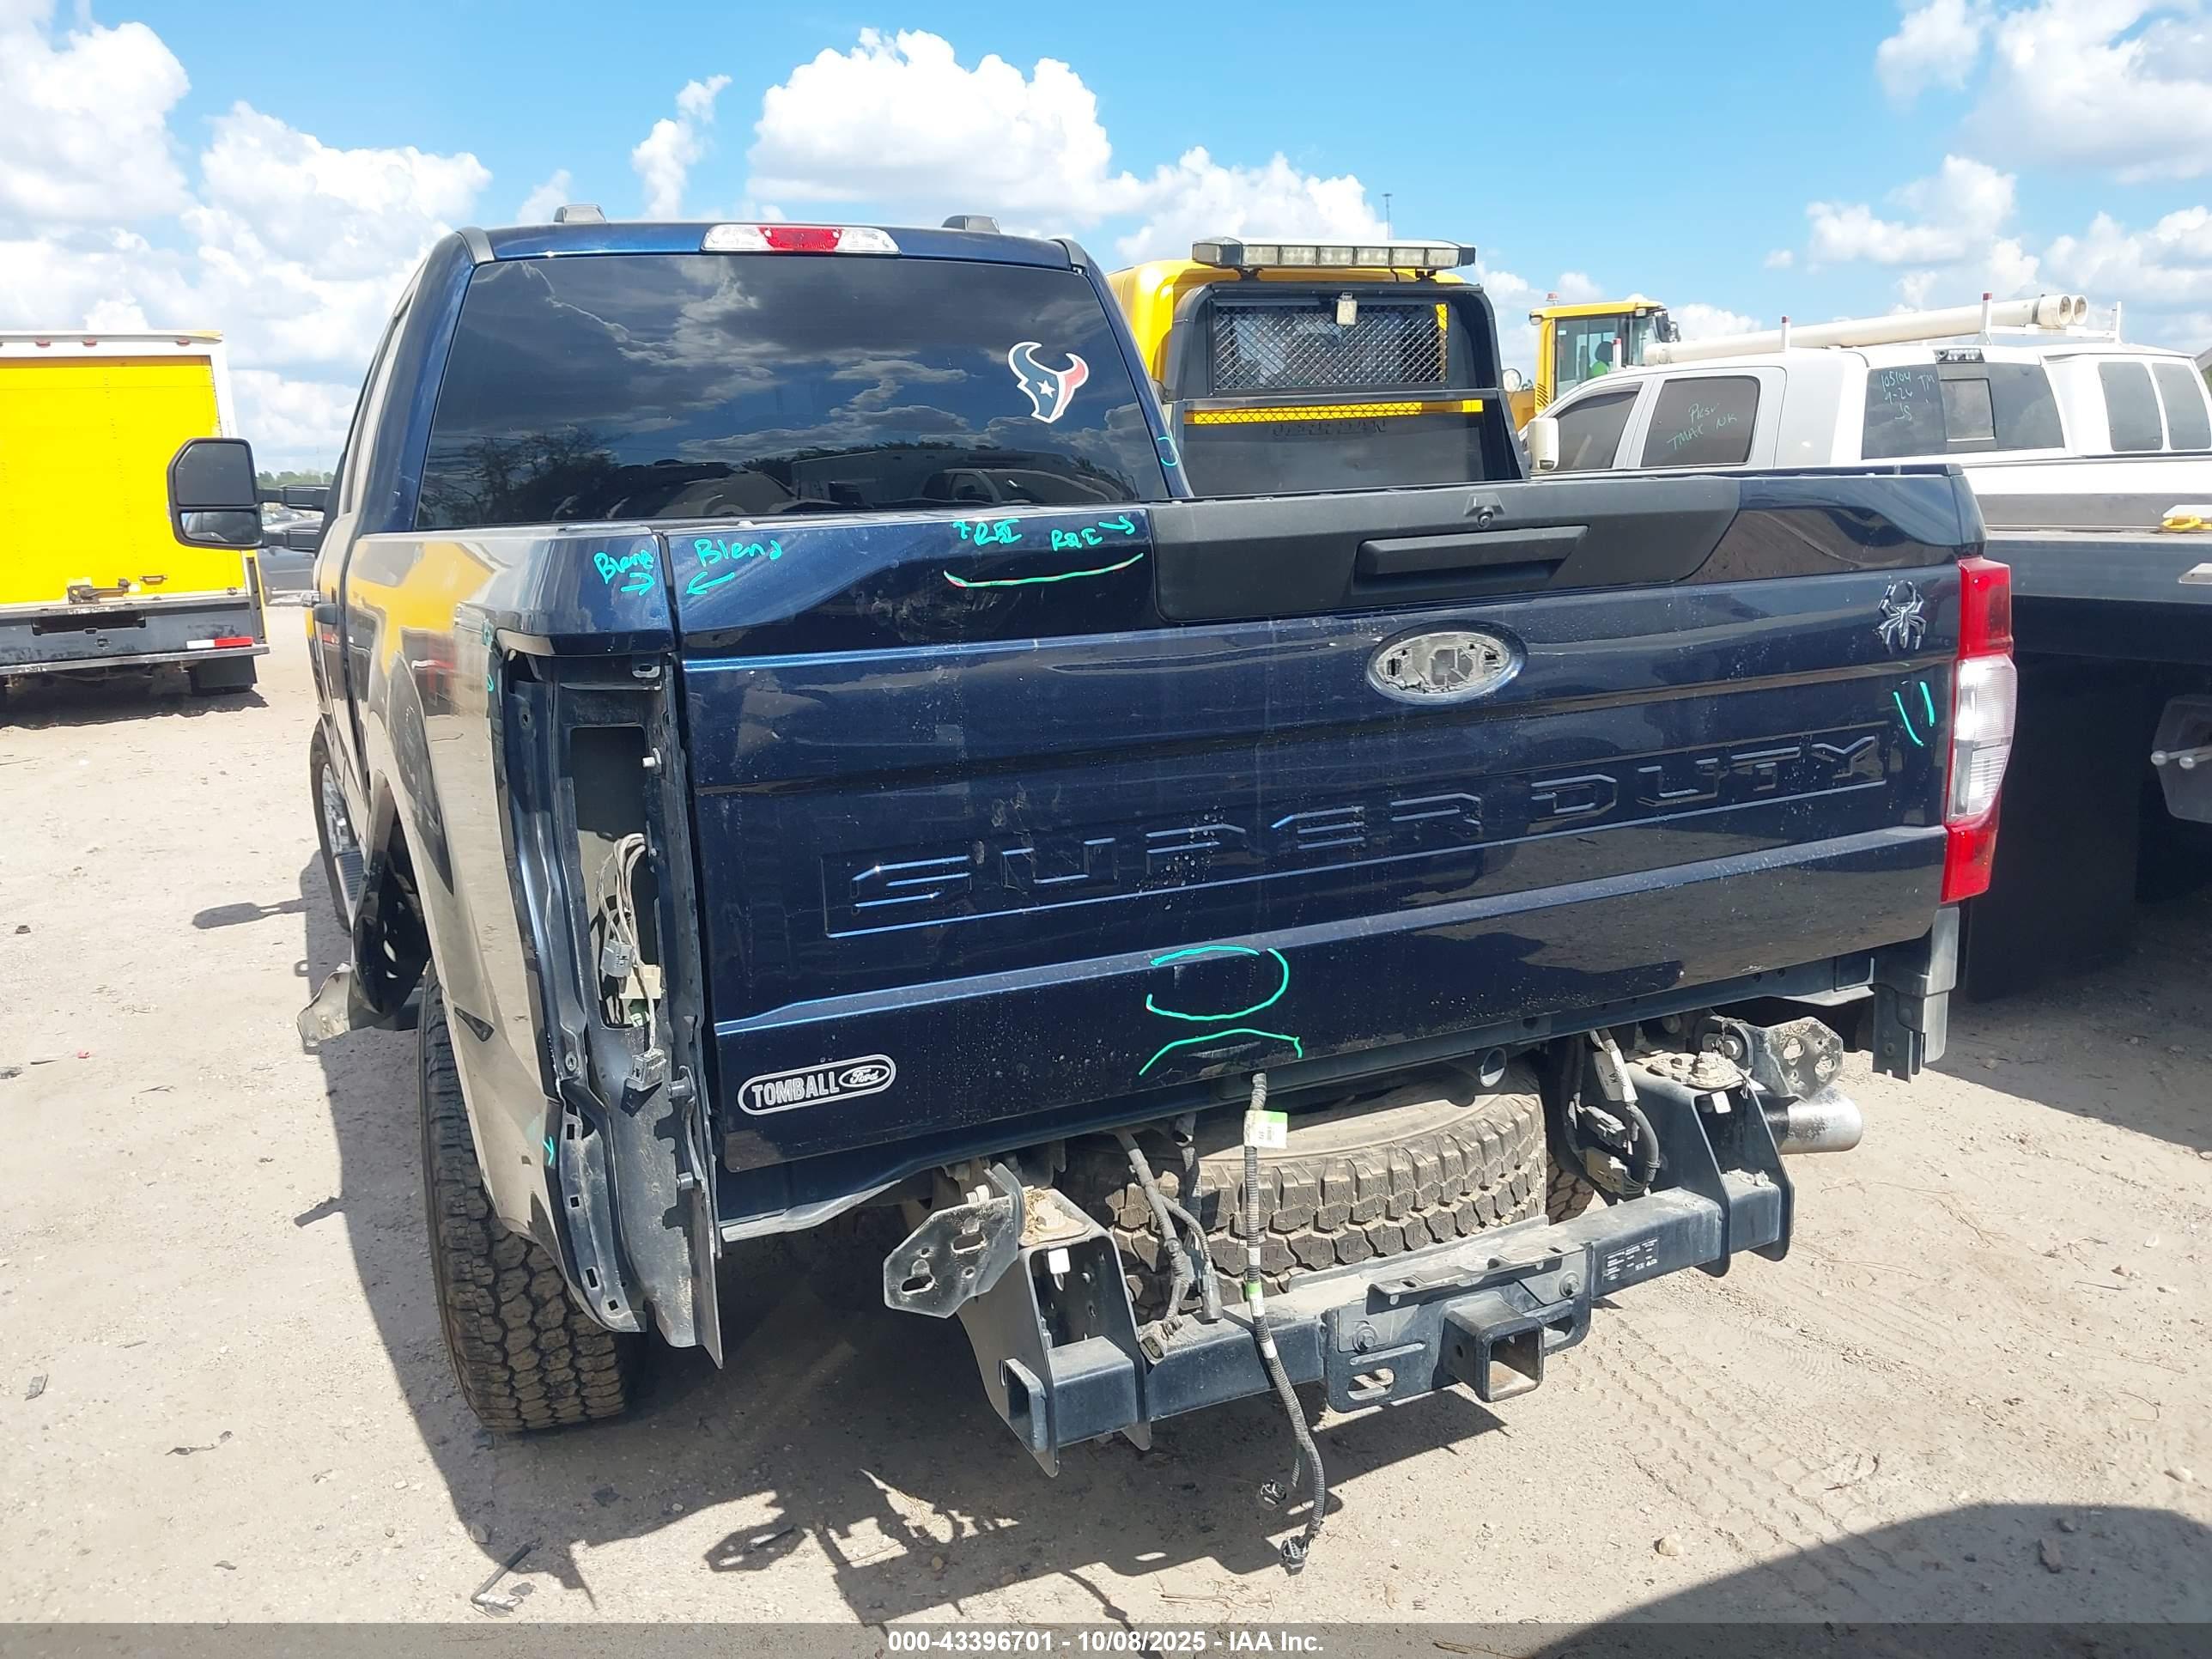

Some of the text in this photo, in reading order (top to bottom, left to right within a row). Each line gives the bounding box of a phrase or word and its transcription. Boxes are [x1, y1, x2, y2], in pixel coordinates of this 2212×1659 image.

[851, 735, 1881, 915] SUPER DUTY
[751, 1068, 879, 1107] TOMBALL Ford
